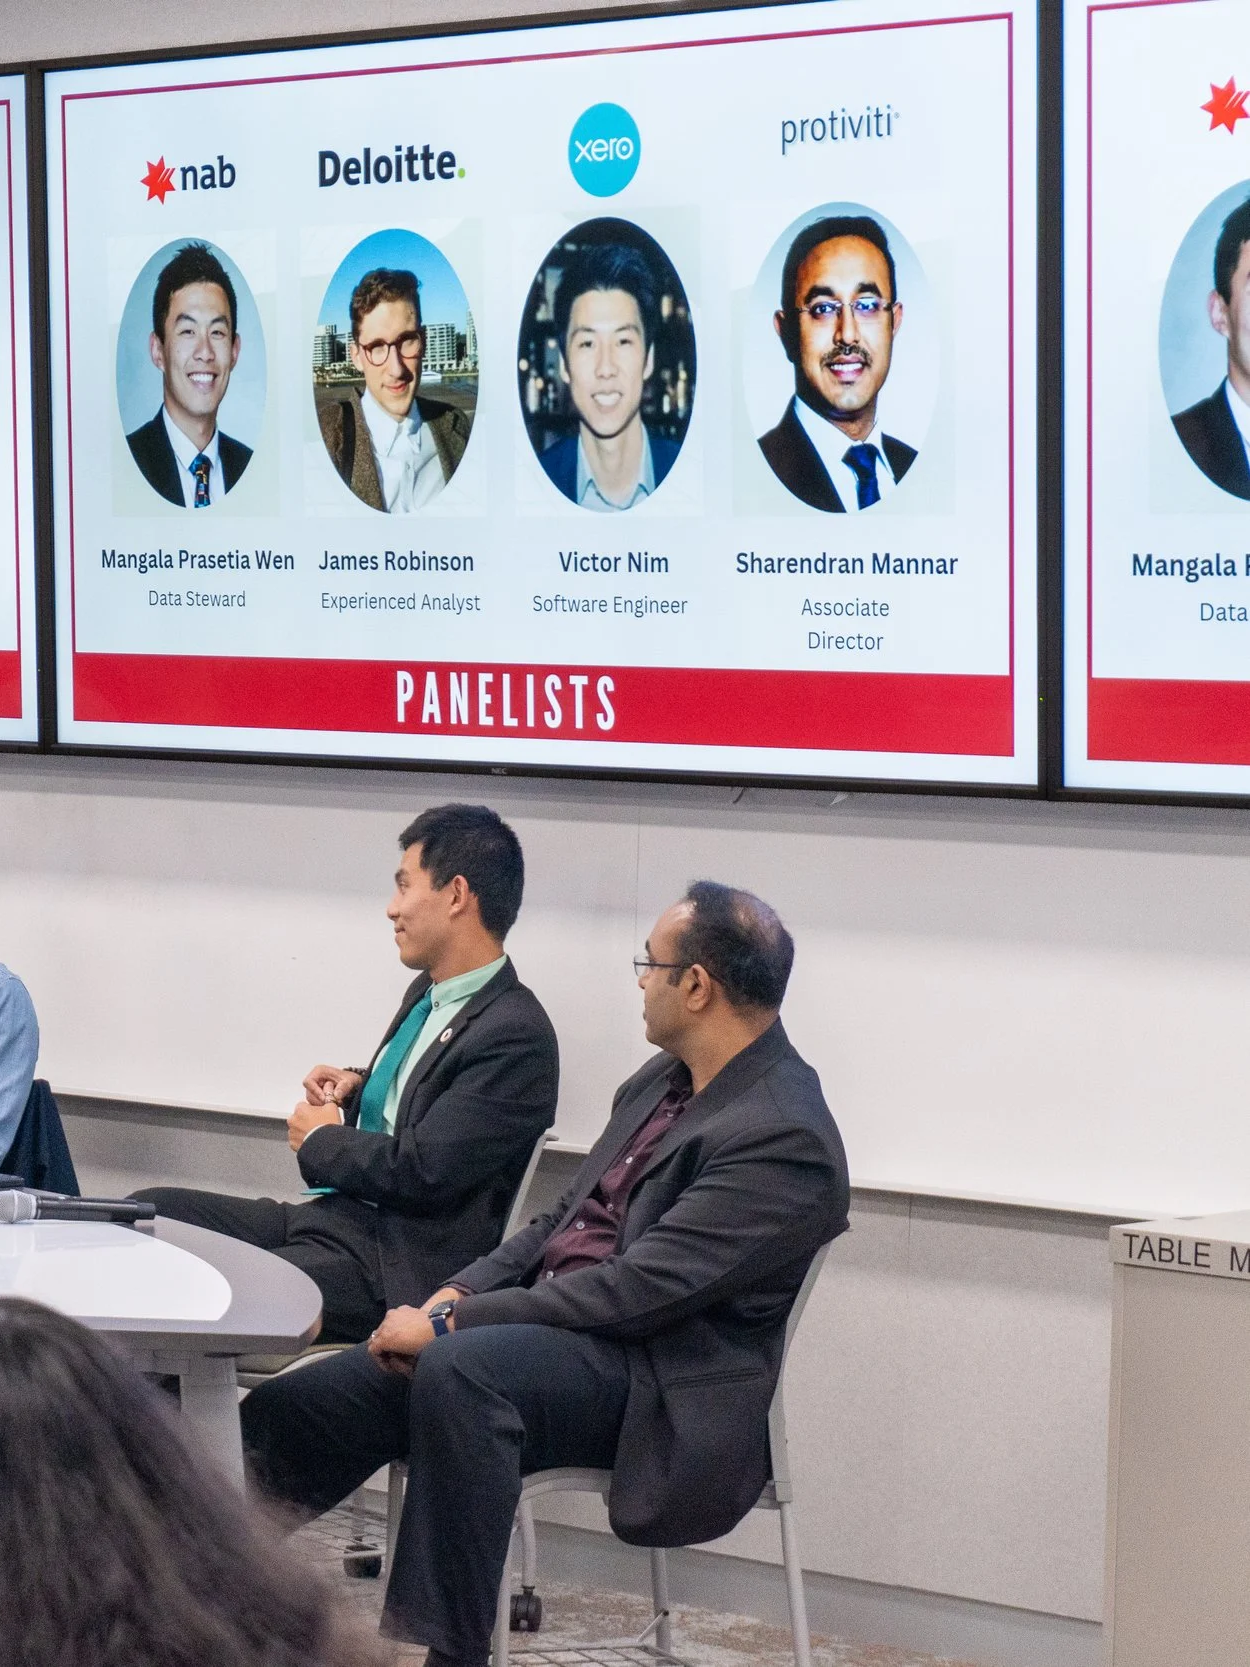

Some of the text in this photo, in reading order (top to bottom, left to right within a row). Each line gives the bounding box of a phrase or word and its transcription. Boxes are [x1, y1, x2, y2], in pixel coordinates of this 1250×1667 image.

[782, 105, 897, 155] protiviti
[574, 137, 634, 163] xero
[180, 155, 235, 190] nab
[102, 550, 294, 574] Mangala Prasetia Wen
[319, 551, 473, 571] James Robinson
[559, 552, 668, 572] Victor Nim
[737, 552, 958, 574] Sharendran Mannar
[1133, 553, 1237, 583] Mangala
[149, 591, 245, 607] Data Steward
[322, 593, 480, 615] Experienced Analyst
[533, 595, 687, 618] Software Engineer
[802, 599, 889, 616] Associate
[1201, 603, 1248, 621] Data
[809, 631, 883, 650] Director
[396, 670, 616, 731] PANELISTS
[1123, 1233, 1211, 1268] TABLE
